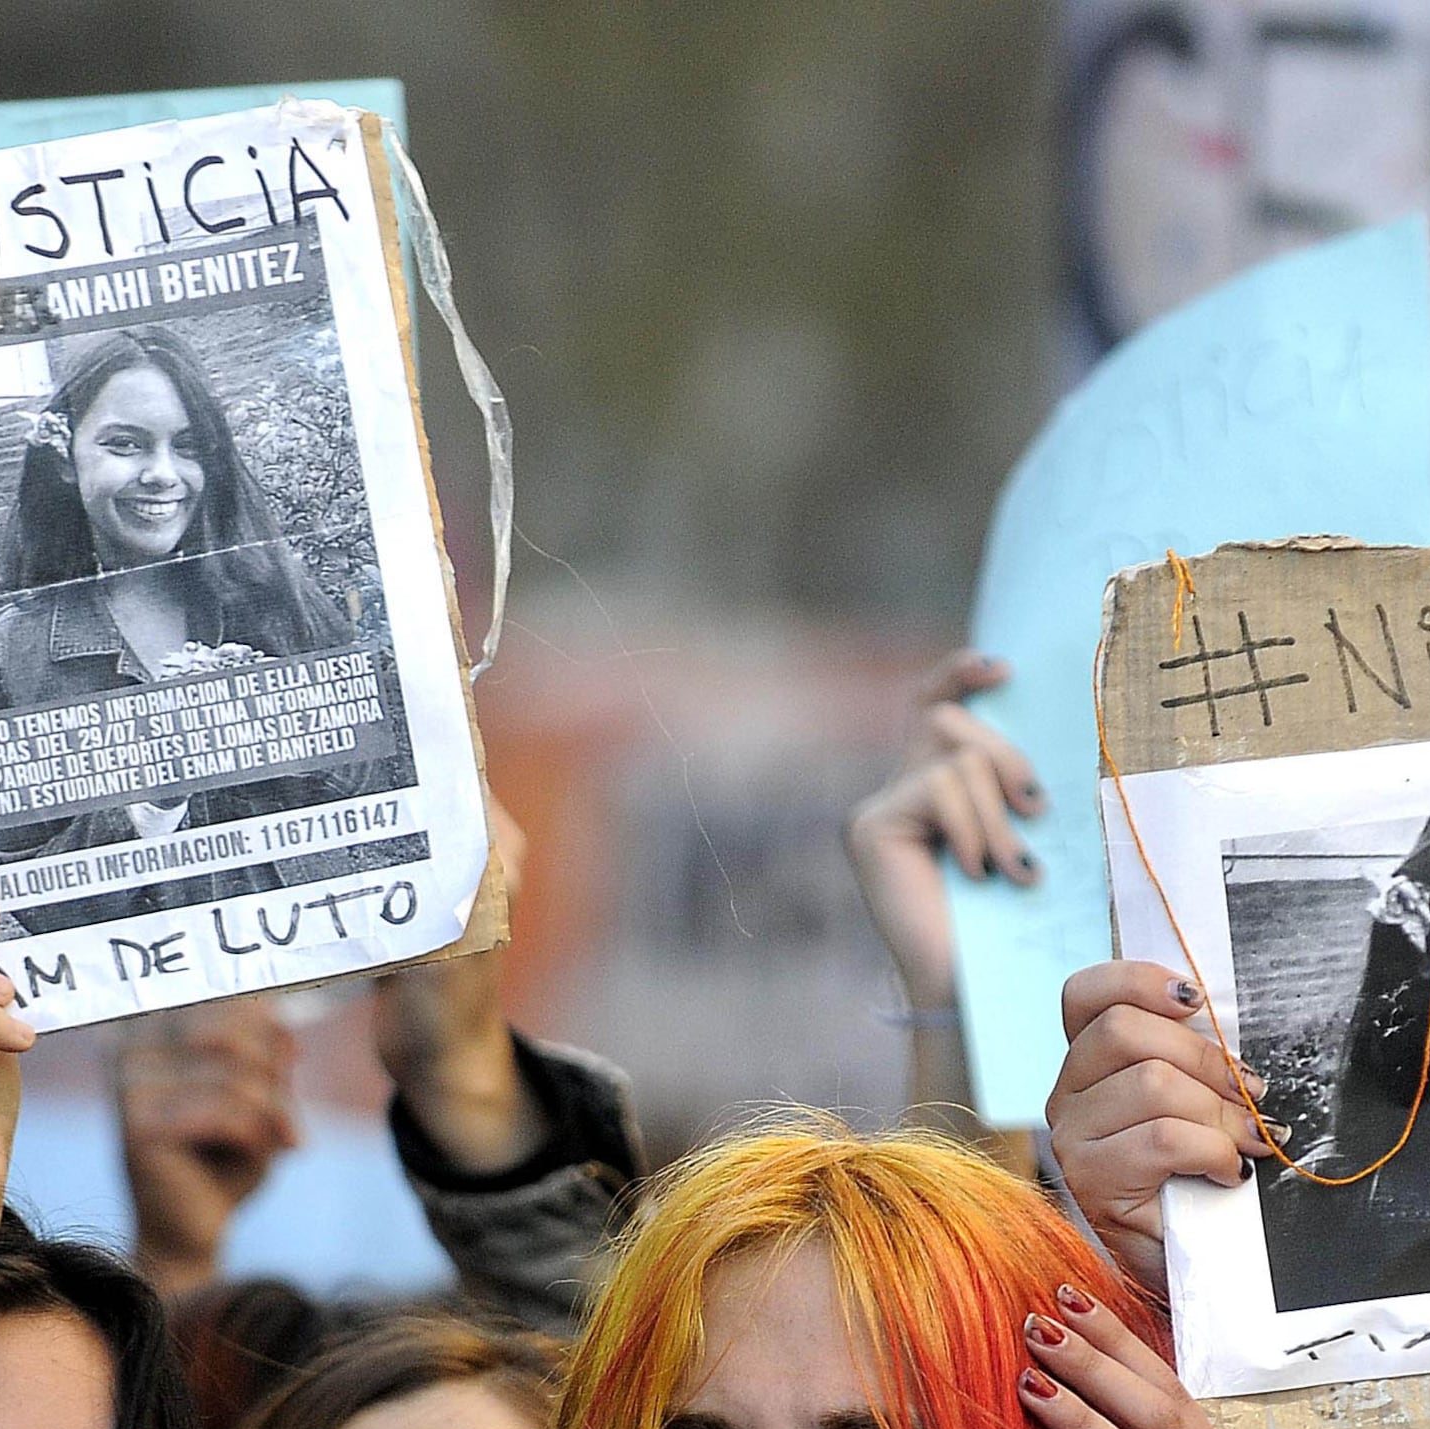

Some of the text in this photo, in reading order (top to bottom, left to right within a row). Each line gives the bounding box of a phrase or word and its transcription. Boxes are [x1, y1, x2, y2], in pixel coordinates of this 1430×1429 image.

[47, 268, 151, 321] ANAHI
[160, 240, 306, 304] BENITEZ
[14, 703, 101, 738] TENEMOS
[105, 678, 231, 722] INFORMACION
[235, 674, 263, 698] DE
[264, 664, 311, 693] ELLA
[316, 651, 375, 682] DESDE
[36, 734, 73, 758] DEL
[151, 713, 173, 737] SU
[182, 700, 251, 732] ULTIMA
[255, 674, 380, 717] INFORMACION
[29, 766, 143, 808] ESTUDIANTE
[144, 762, 180, 789] DEL
[183, 748, 237, 780] ENAM
[239, 745, 265, 770] DE
[269, 726, 357, 764] BANFIELD
[65, 752, 93, 777] DE
[96, 733, 185, 772] DEPORTES
[187, 728, 214, 752] DE
[215, 716, 278, 749] LOMAS
[279, 711, 307, 735] DE
[306, 697, 384, 731] ZAMORA
[96, 833, 254, 883] INFORMACION:
[260, 800, 401, 851] 1167116147
[108, 880, 420, 982] DE LUTO
